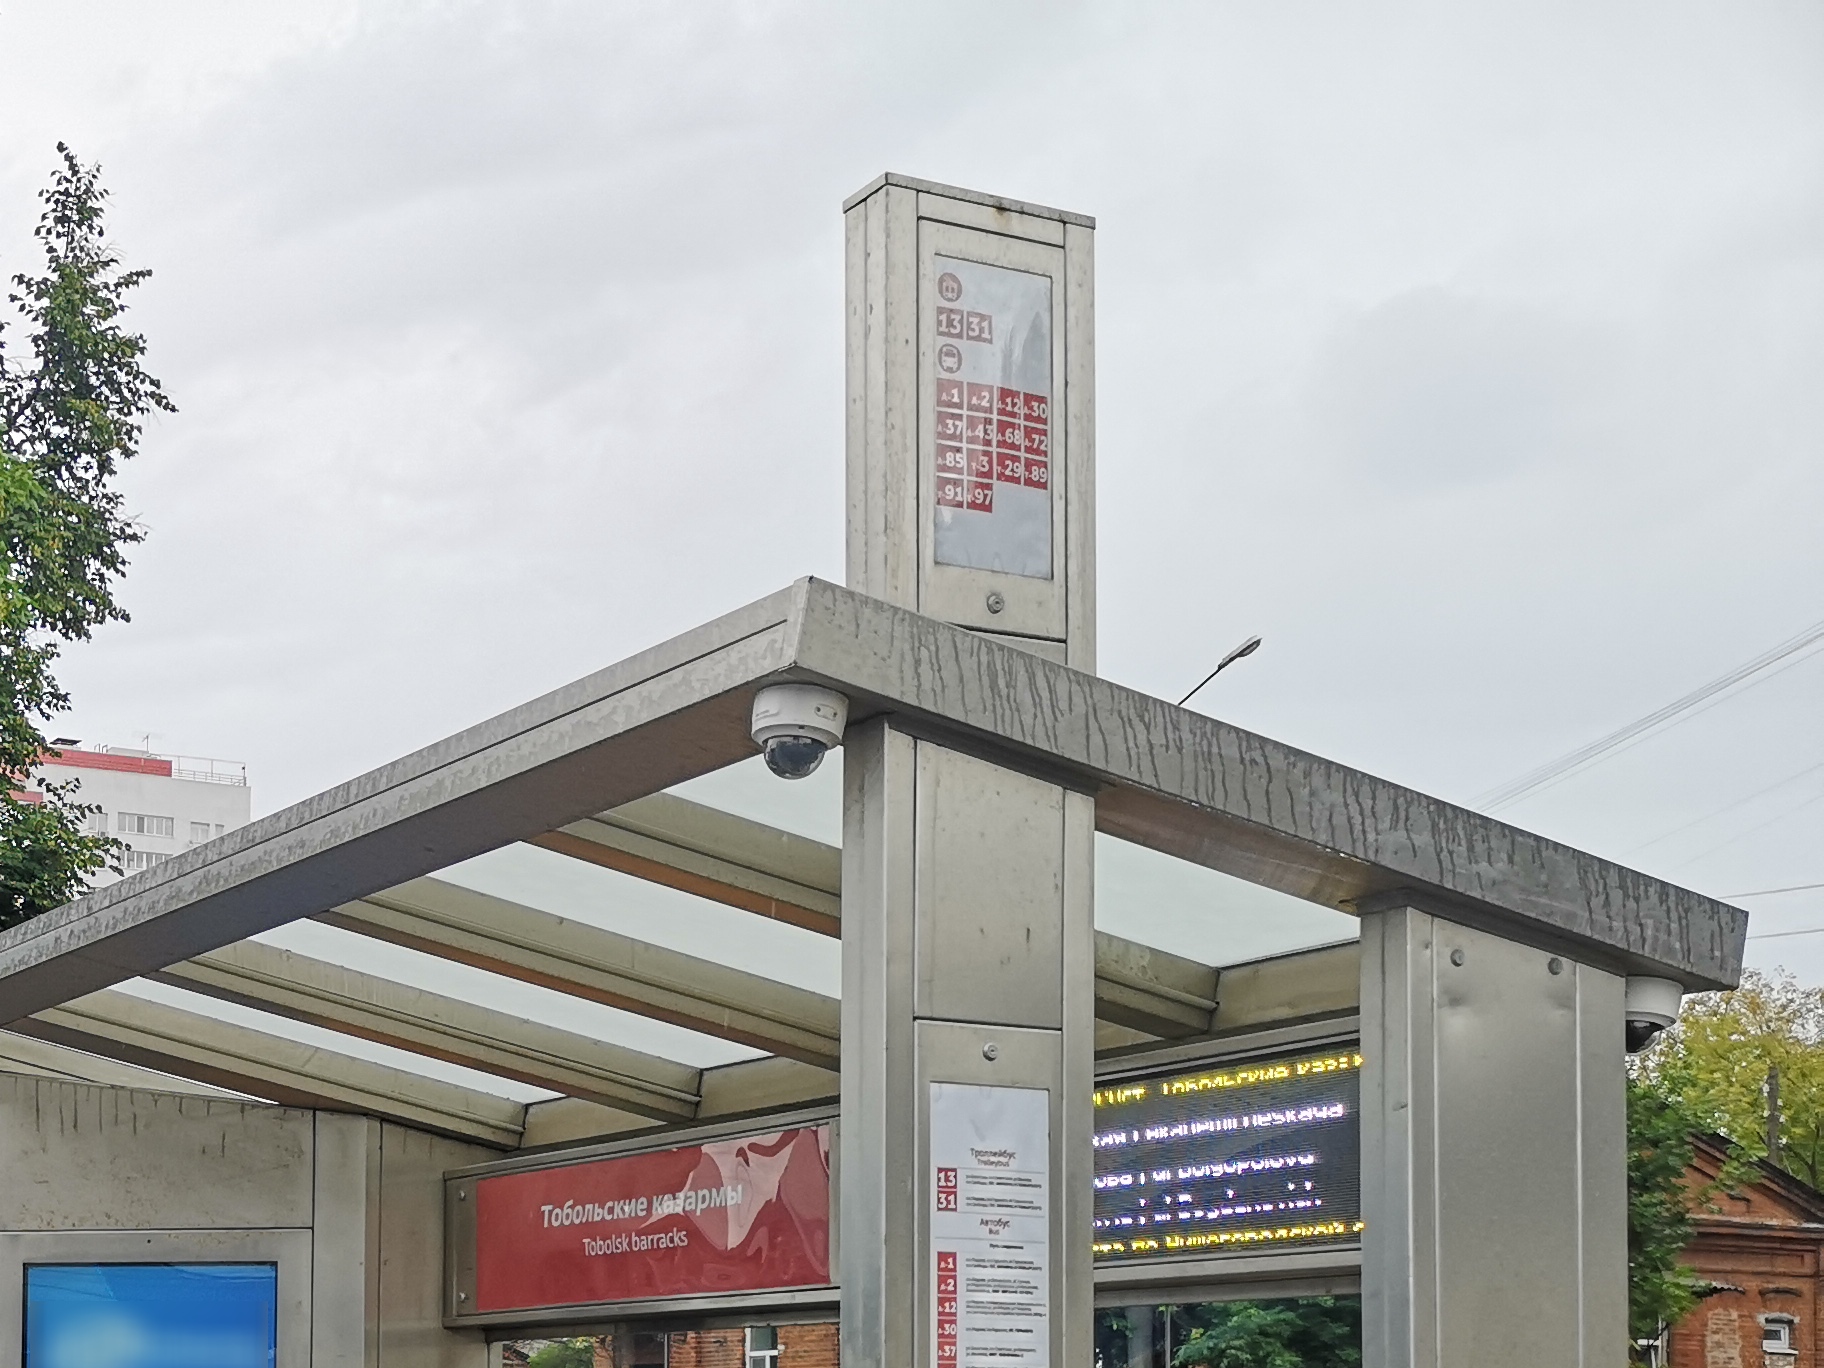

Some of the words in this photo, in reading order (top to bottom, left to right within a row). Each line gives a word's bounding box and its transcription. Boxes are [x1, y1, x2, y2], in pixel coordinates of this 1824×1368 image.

[938, 313, 962, 334] 13
[968, 317, 991, 339] 31
[941, 387, 960, 403] А-1
[971, 391, 990, 407] А-2
[997, 396, 1021, 414] А-12
[1023, 401, 1048, 419] А-30
[937, 418, 963, 435] А-37
[967, 423, 993, 440] А-43
[997, 428, 1021, 445] А-68
[1024, 434, 1048, 451] А-72
[937, 452, 964, 468] А-85
[997, 460, 1021, 477] Т-29
[1024, 465, 1047, 483] Т-89
[970, 1147, 1017, 1160] Троллейбус
[938, 1171, 956, 1186] 13
[541, 1195, 648, 1229] Тобольские
[651, 1183, 743, 1215] казармы
[938, 1193, 956, 1208] 31
[979, 1218, 1011, 1229] Автобус
[582, 1232, 630, 1256] Tobolsk
[631, 1227, 688, 1251] barracks
